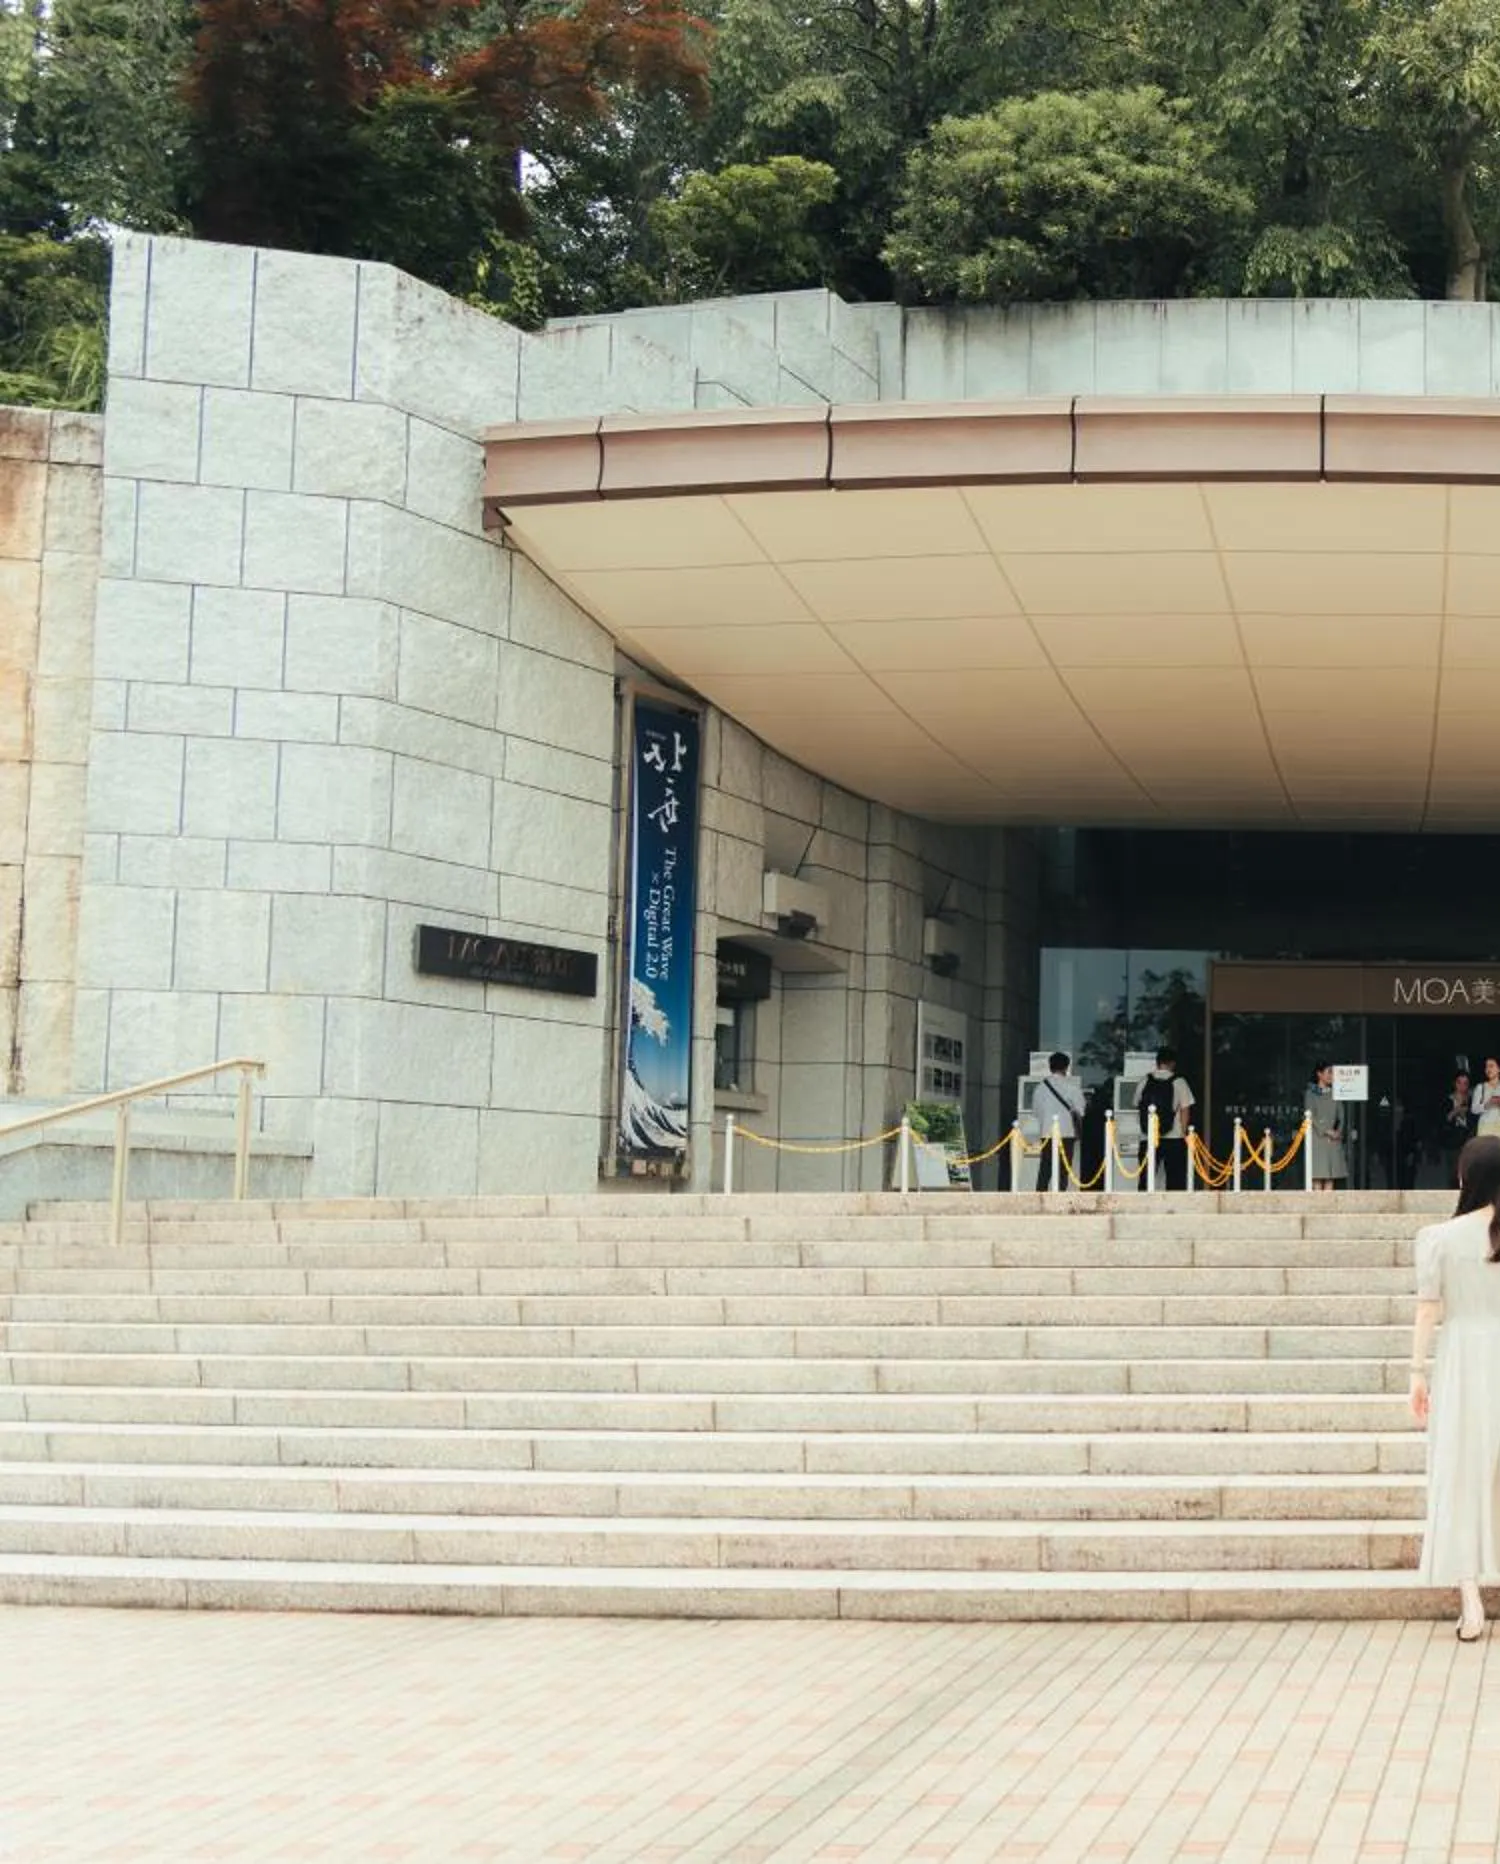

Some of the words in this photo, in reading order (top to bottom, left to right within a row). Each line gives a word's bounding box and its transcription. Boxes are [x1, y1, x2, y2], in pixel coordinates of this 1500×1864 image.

[664, 846, 677, 881] The
[643, 888, 661, 948] Digital
[661, 885, 675, 932] Great
[645, 950, 660, 979] 2.0
[660, 936, 673, 981] Wave
